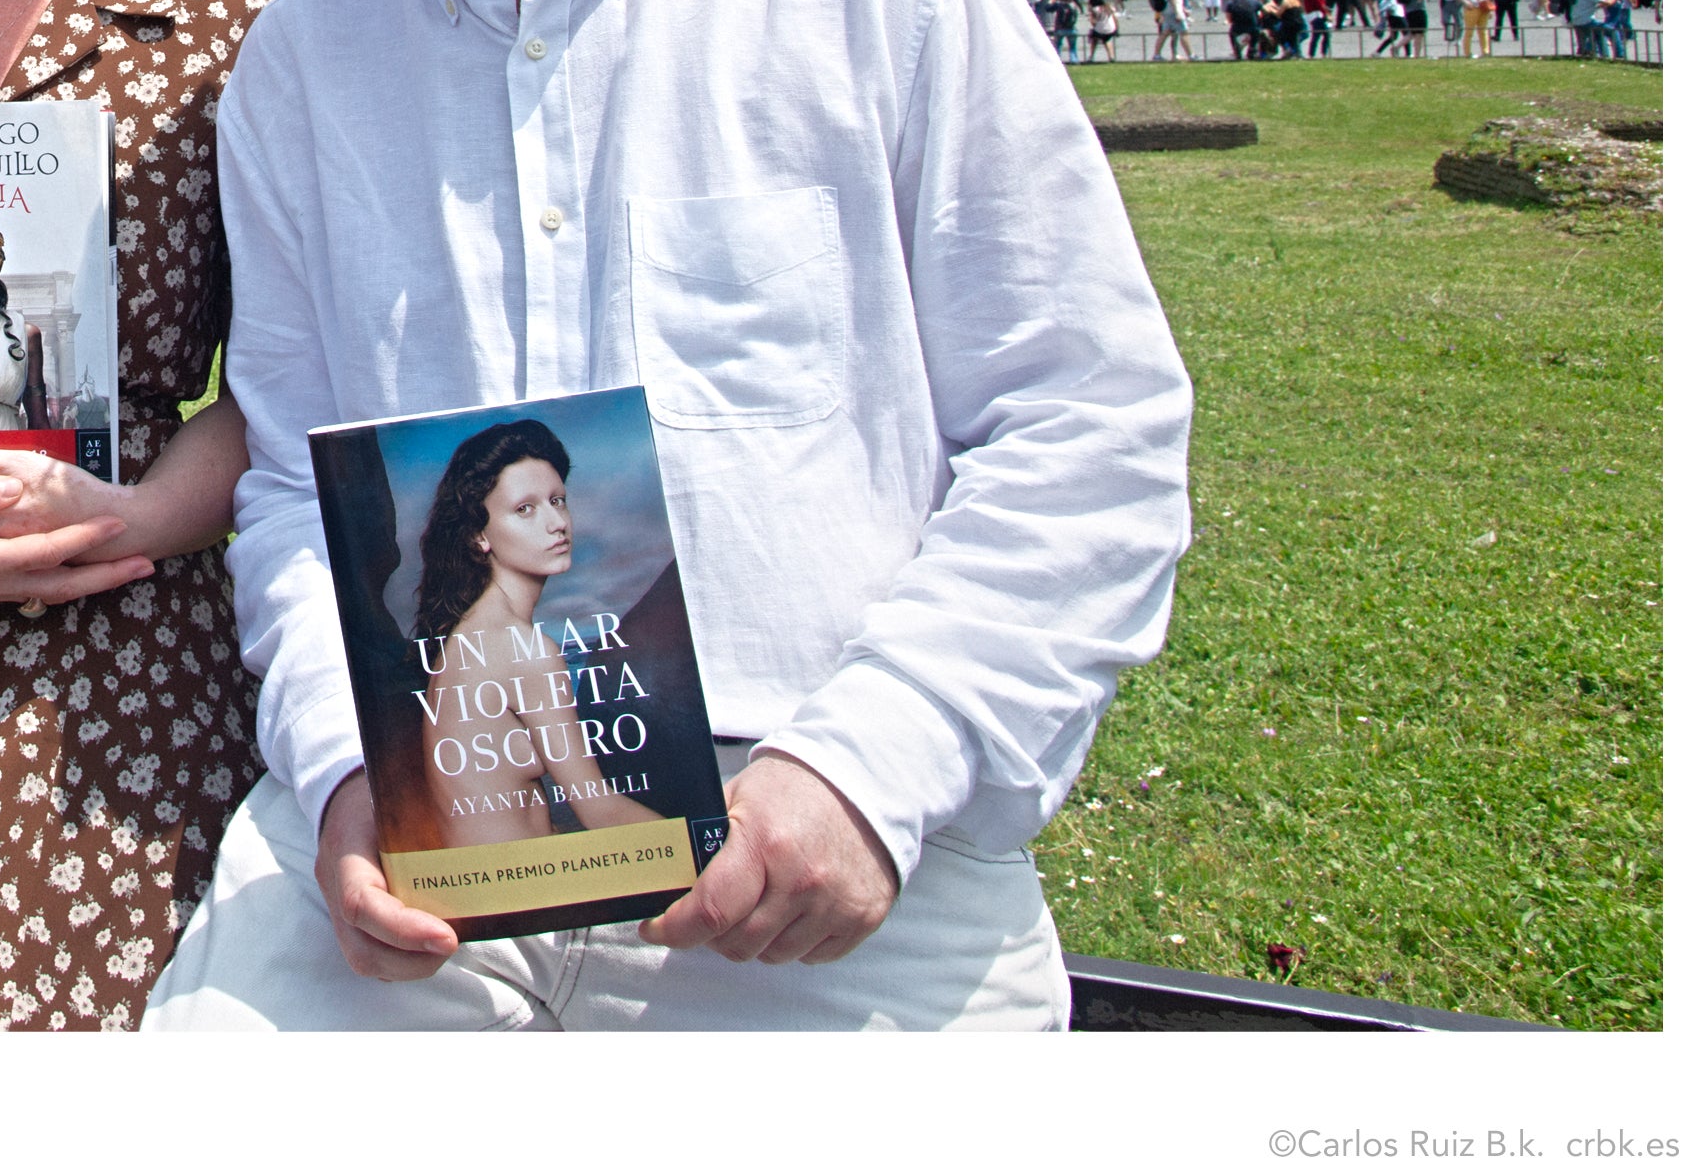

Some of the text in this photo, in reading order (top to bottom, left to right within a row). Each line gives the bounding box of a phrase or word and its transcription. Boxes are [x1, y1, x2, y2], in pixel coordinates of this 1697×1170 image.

[414, 612, 629, 675] UN MAR
[411, 661, 650, 727] VIOLETA
[433, 714, 647, 776] OSCURO
[450, 773, 650, 816] AYANTA BARILLI
[413, 845, 674, 890] FINALISTA PREMIO PLANETA 2018
